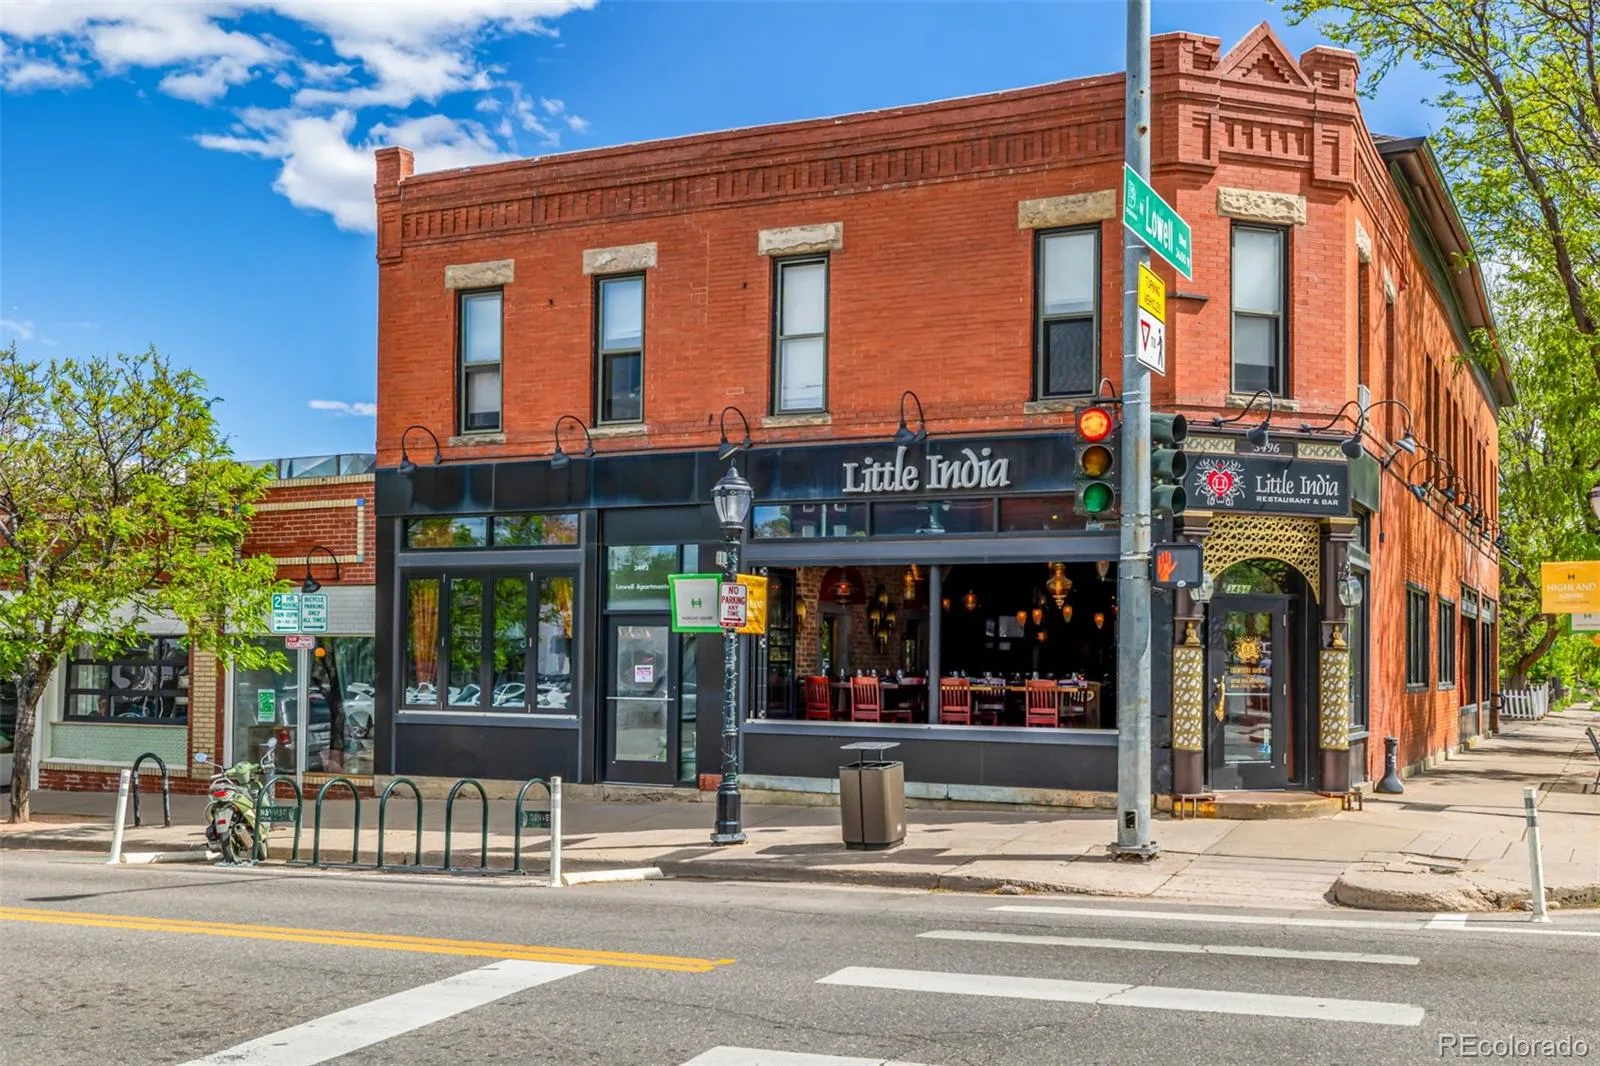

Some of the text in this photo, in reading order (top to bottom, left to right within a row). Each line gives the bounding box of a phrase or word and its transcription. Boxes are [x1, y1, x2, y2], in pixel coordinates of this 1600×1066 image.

[1145, 195, 1173, 253] Lowell
[1145, 275, 1161, 298] TURNING
[1144, 293, 1162, 315] VEHICLES
[842, 446, 1012, 492] Little India
[1255, 469, 1340, 496] Little India
[1256, 495, 1311, 505] RESTAURANT
[1321, 498, 1340, 506] BAR
[615, 583, 635, 591] Lowell
[728, 586, 739, 594] NO
[1547, 582, 1597, 593] HIGHLAND
[274, 596, 281, 608] 2
[721, 595, 745, 605] PARKING
